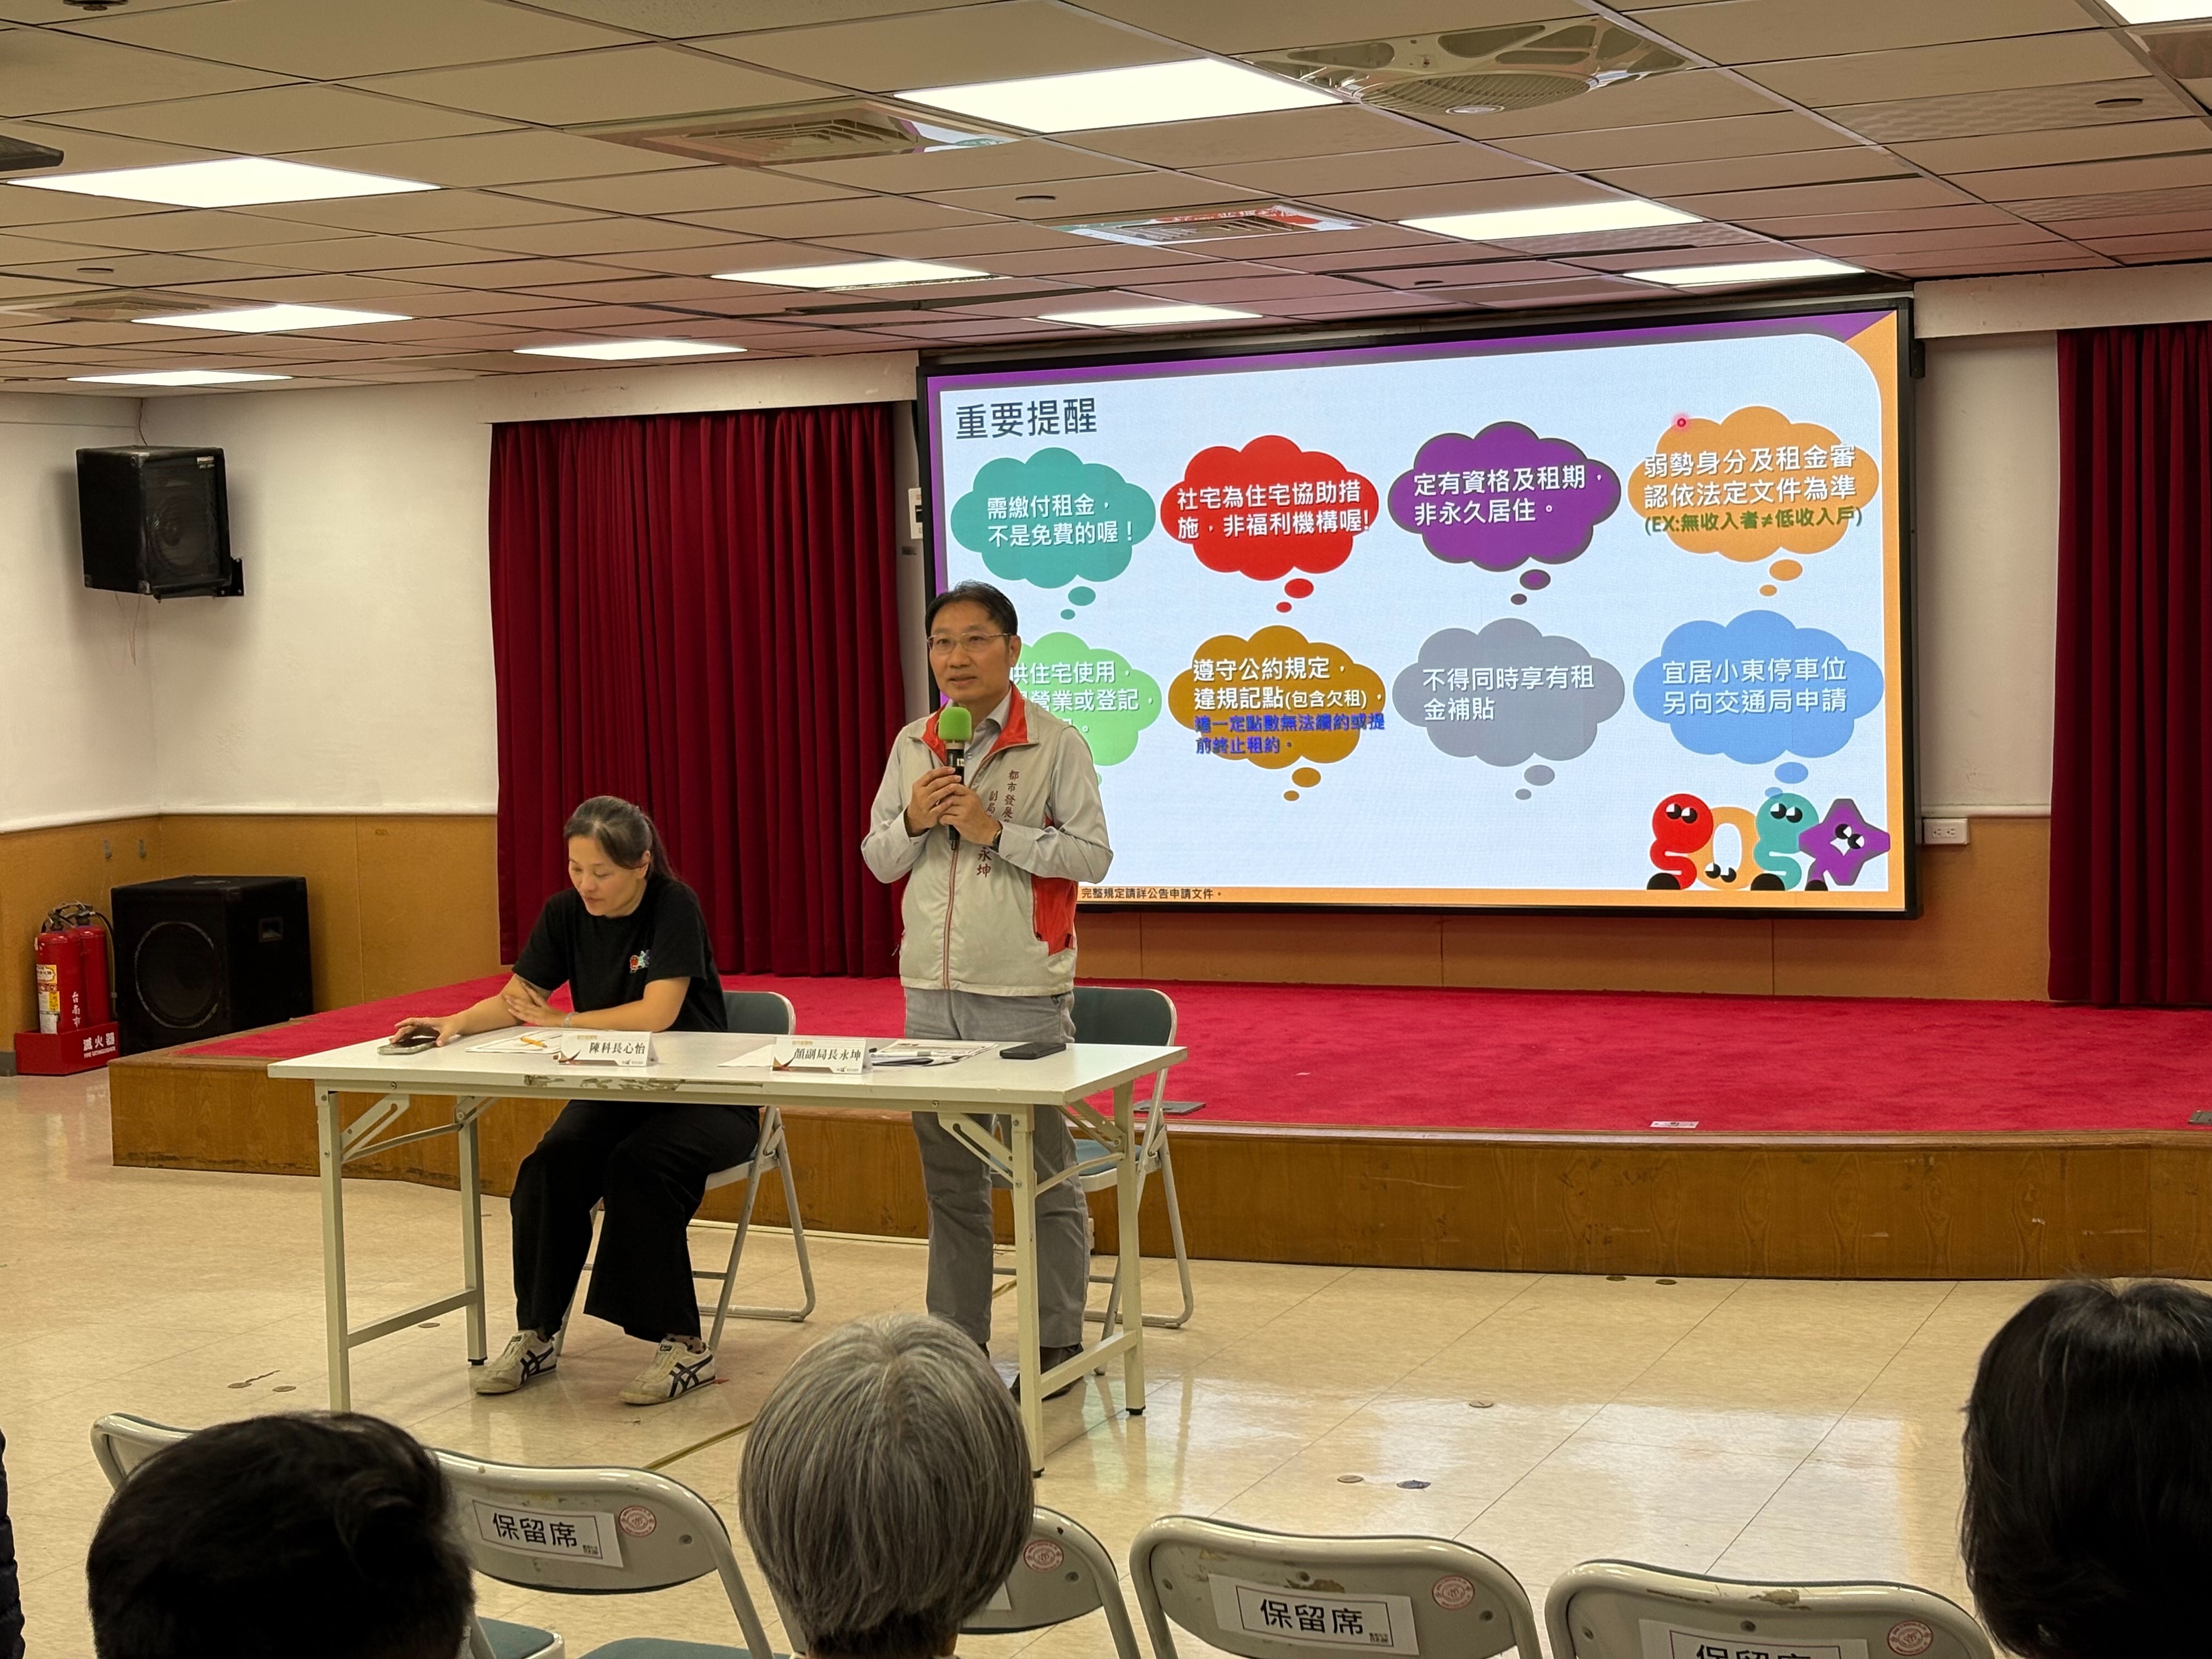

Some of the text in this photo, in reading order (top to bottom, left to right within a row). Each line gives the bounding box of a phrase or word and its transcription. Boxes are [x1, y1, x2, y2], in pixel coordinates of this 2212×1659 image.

[955, 397, 1097, 440] 重要提醒
[1644, 442, 1857, 479] 弱勢身分及租金審
[1177, 479, 1361, 511] 社宅為住宅協助措
[1414, 464, 1603, 497] 定有資格及租期，
[1644, 474, 1857, 509] 認依法定文件為準
[988, 493, 1109, 521] 需繳付租金，
[1414, 498, 1554, 527] 非永久居住。
[1193, 657, 1345, 682] 遵守公約規定，
[1423, 664, 1595, 692] 不得同時享有租
[1662, 656, 1847, 686] 宜居小東停車位
[1423, 696, 1495, 722] 金補貼
[1662, 687, 1847, 716] 另向交通局申請
[986, 790, 999, 817] 副局
[1002, 769, 1020, 823] 都市發展
[83, 1032, 115, 1051] 滅火器
[589, 1041, 646, 1055] 陳科長心怡
[794, 1047, 861, 1062] 顏副局長永坤
[493, 1512, 578, 1548] 保留席
[1260, 1599, 1363, 1635] 保留席
